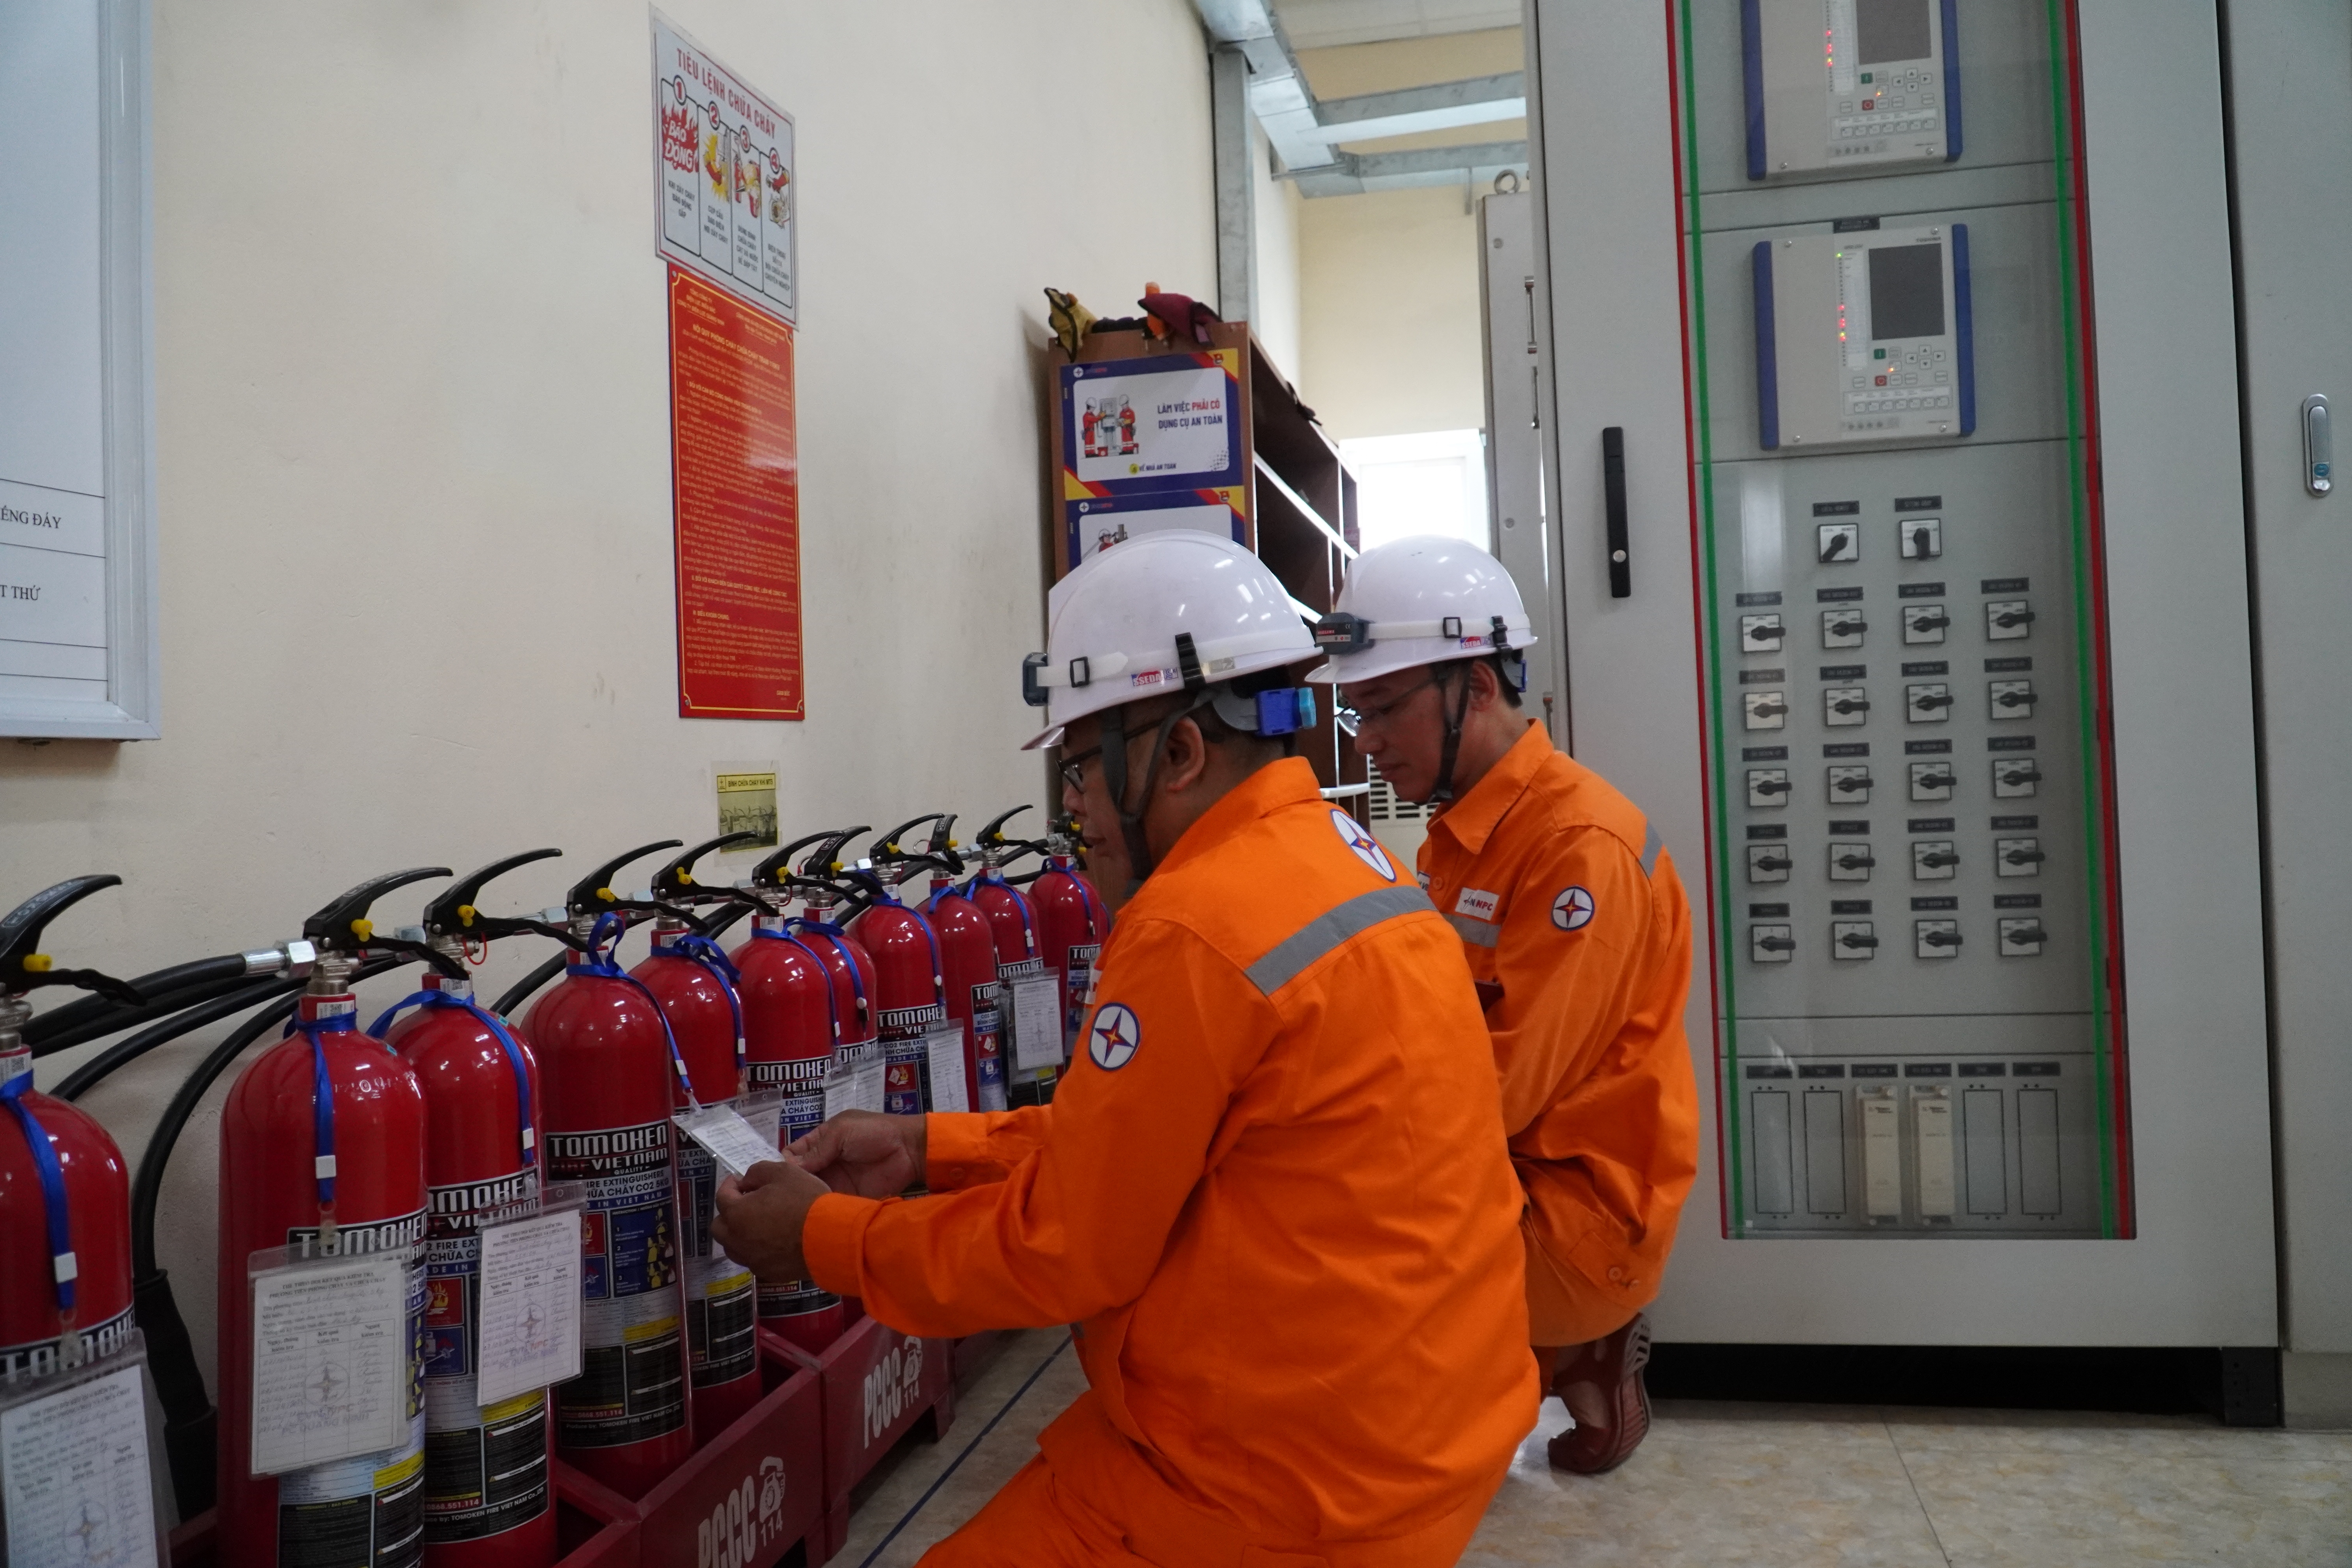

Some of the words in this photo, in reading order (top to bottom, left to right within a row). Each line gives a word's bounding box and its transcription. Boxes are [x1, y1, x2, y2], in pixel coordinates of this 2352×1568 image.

[677, 81, 682, 100] 1
[710, 105, 718, 125] 2
[742, 130, 748, 149] 3
[1158, 404, 1172, 415] LÀM
[1174, 402, 1190, 415] VIỆC
[1192, 398, 1209, 411] PHẢI
[1210, 398, 1220, 409] CÓ
[1158, 417, 1178, 431] DỤNG
[1180, 417, 1190, 429] CỤ
[1191, 416, 1201, 426] AN
[1203, 414, 1223, 425] TOÀN
[0, 505, 29, 524] ẾNG
[33, 512, 62, 529] ĐÁY
[11, 585, 41, 601] THỨ
[777, 1079, 823, 1092] VIETNA
[785, 1096, 824, 1107] EXTINGUISHE
[788, 1103, 808, 1114] CHÁY
[550, 1125, 667, 1157] TOMOKEN
[591, 1147, 667, 1170] VIETNAM
[586, 1180, 600, 1189] IRE
[603, 1169, 664, 1187] EXTINGUISHERS
[614, 1166, 643, 1175] QUALITY
[587, 1189, 605, 1198] HỮA
[607, 1185, 635, 1196] CHÁY
[636, 1181, 654, 1192] CO2
[656, 1177, 669, 1188] 5KG
[616, 1196, 639, 1205] VIET
[644, 1191, 662, 1200] NAM
[429, 1249, 464, 1262] CHỮA
[436, 1241, 458, 1251] FIRE
[864, 1347, 902, 1449] PCCC
[904, 1379, 920, 1409] 114
[599, 1419, 628, 1428] TOMOKEN
[451, 1510, 485, 1521] TOMOKEN
[486, 1506, 499, 1515] FIRE
[500, 1501, 514, 1511] VIET
[514, 1495, 528, 1506] NAM
[698, 1475, 756, 1568] PCCC
[760, 1508, 783, 1547] 114
